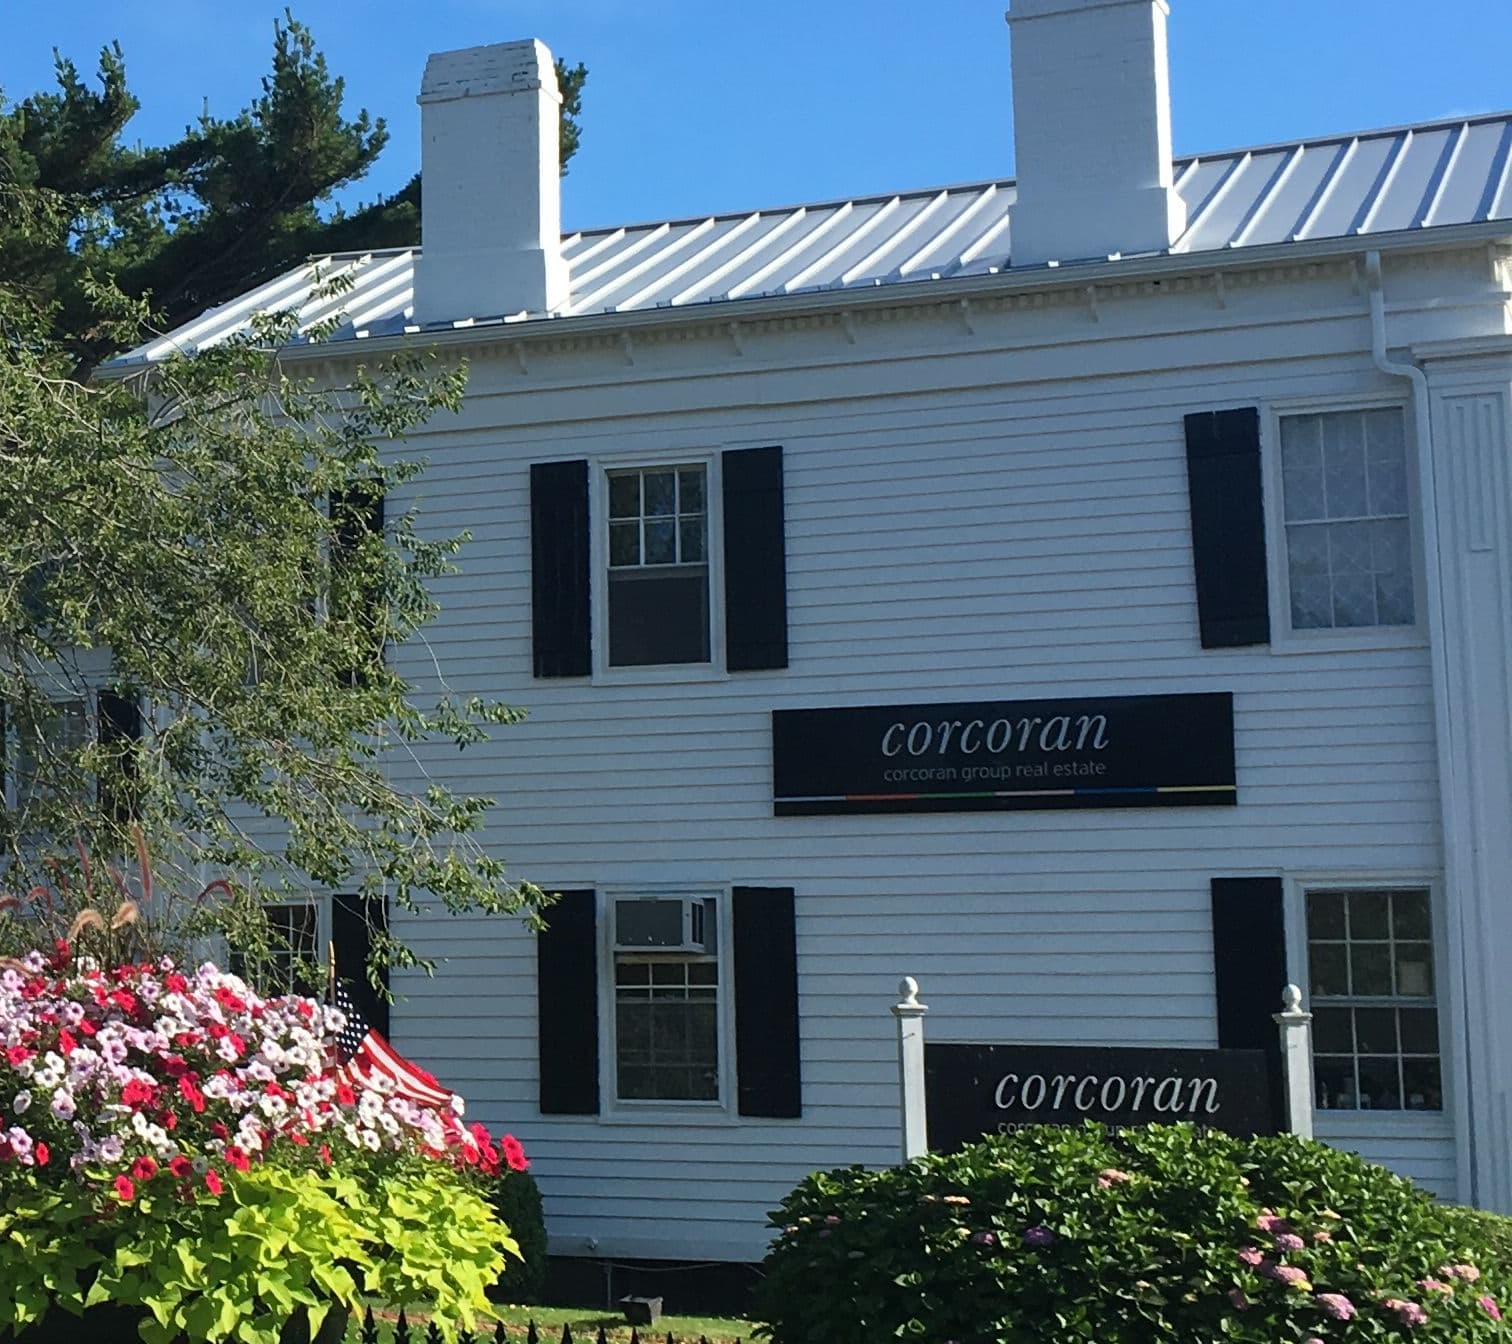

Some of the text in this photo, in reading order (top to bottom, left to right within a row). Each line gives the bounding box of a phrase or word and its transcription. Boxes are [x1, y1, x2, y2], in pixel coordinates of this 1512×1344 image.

[881, 714, 1110, 757] corcoran
[883, 760, 1107, 783] corcoran group real estate
[994, 1072, 1221, 1114] corcoran
